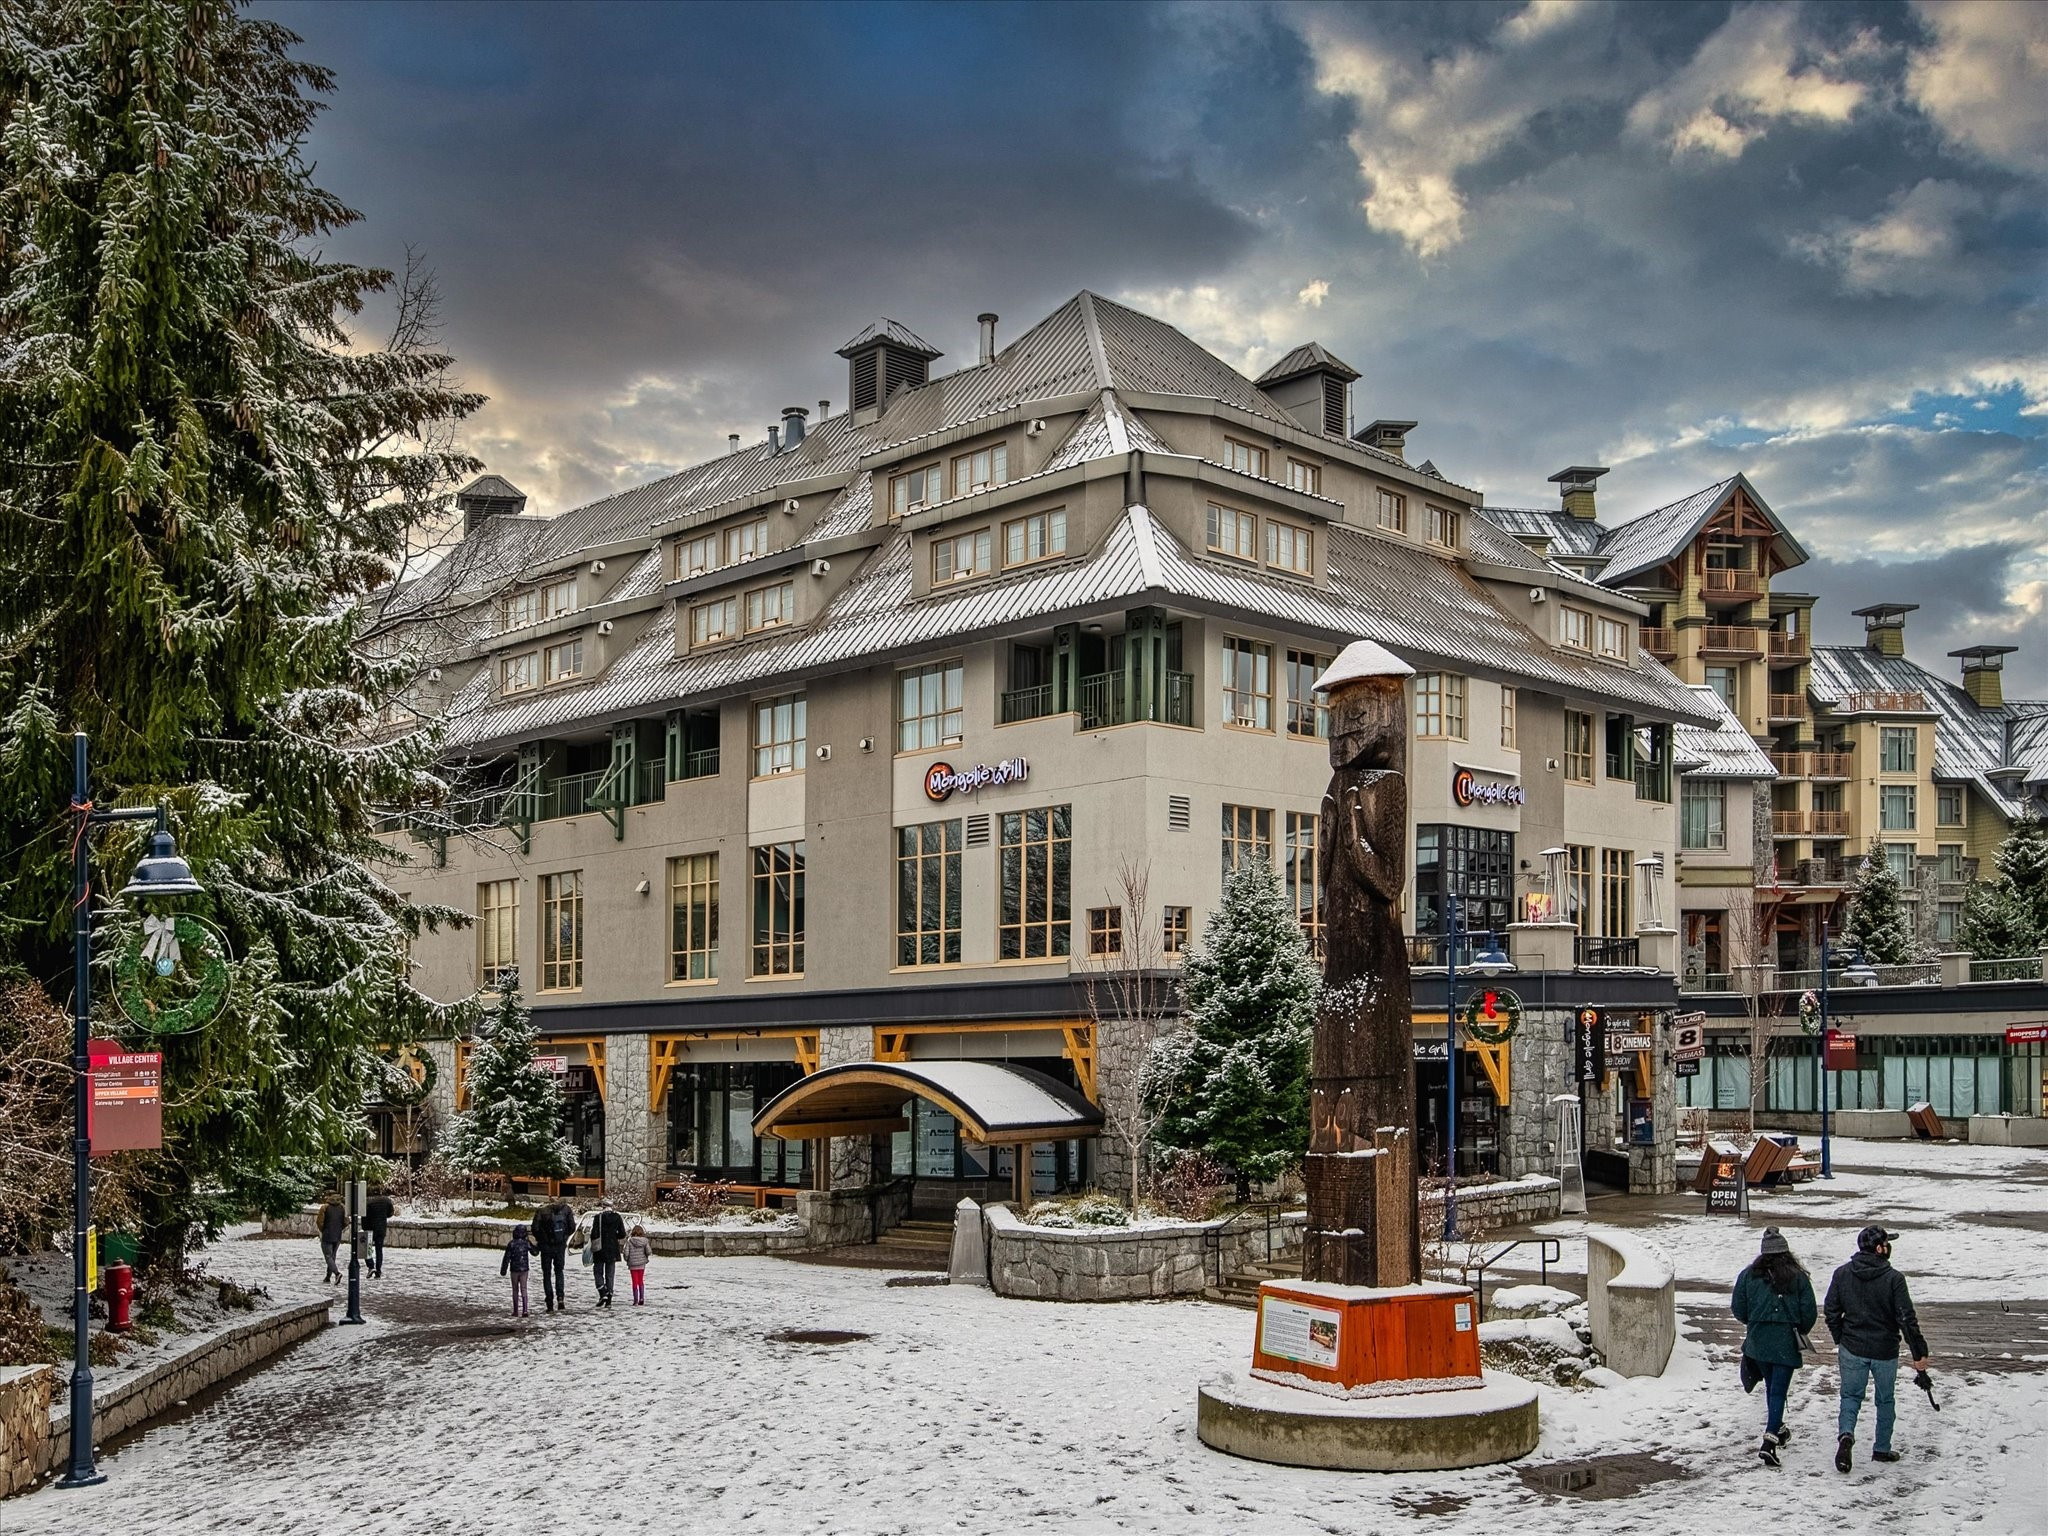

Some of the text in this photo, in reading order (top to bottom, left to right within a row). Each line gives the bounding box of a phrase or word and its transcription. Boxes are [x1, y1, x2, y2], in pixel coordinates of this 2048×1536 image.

[930, 757, 1024, 793] Mongolie Grill
[1507, 784, 1526, 805] Grill
[1674, 1015, 1702, 1025] VILLAGE
[1614, 1036, 1622, 1050] 8
[1622, 1036, 1651, 1048] CINEMAS
[1678, 1029, 1697, 1045] 8
[1428, 1042, 1449, 1056] Grill
[1582, 1011, 1596, 1080] Mongolie Grill
[108, 1054, 158, 1065] VILLAGE CENTRE
[1673, 1049, 1702, 1060] CINEMAS
[1711, 1190, 1737, 1199] OPEN
